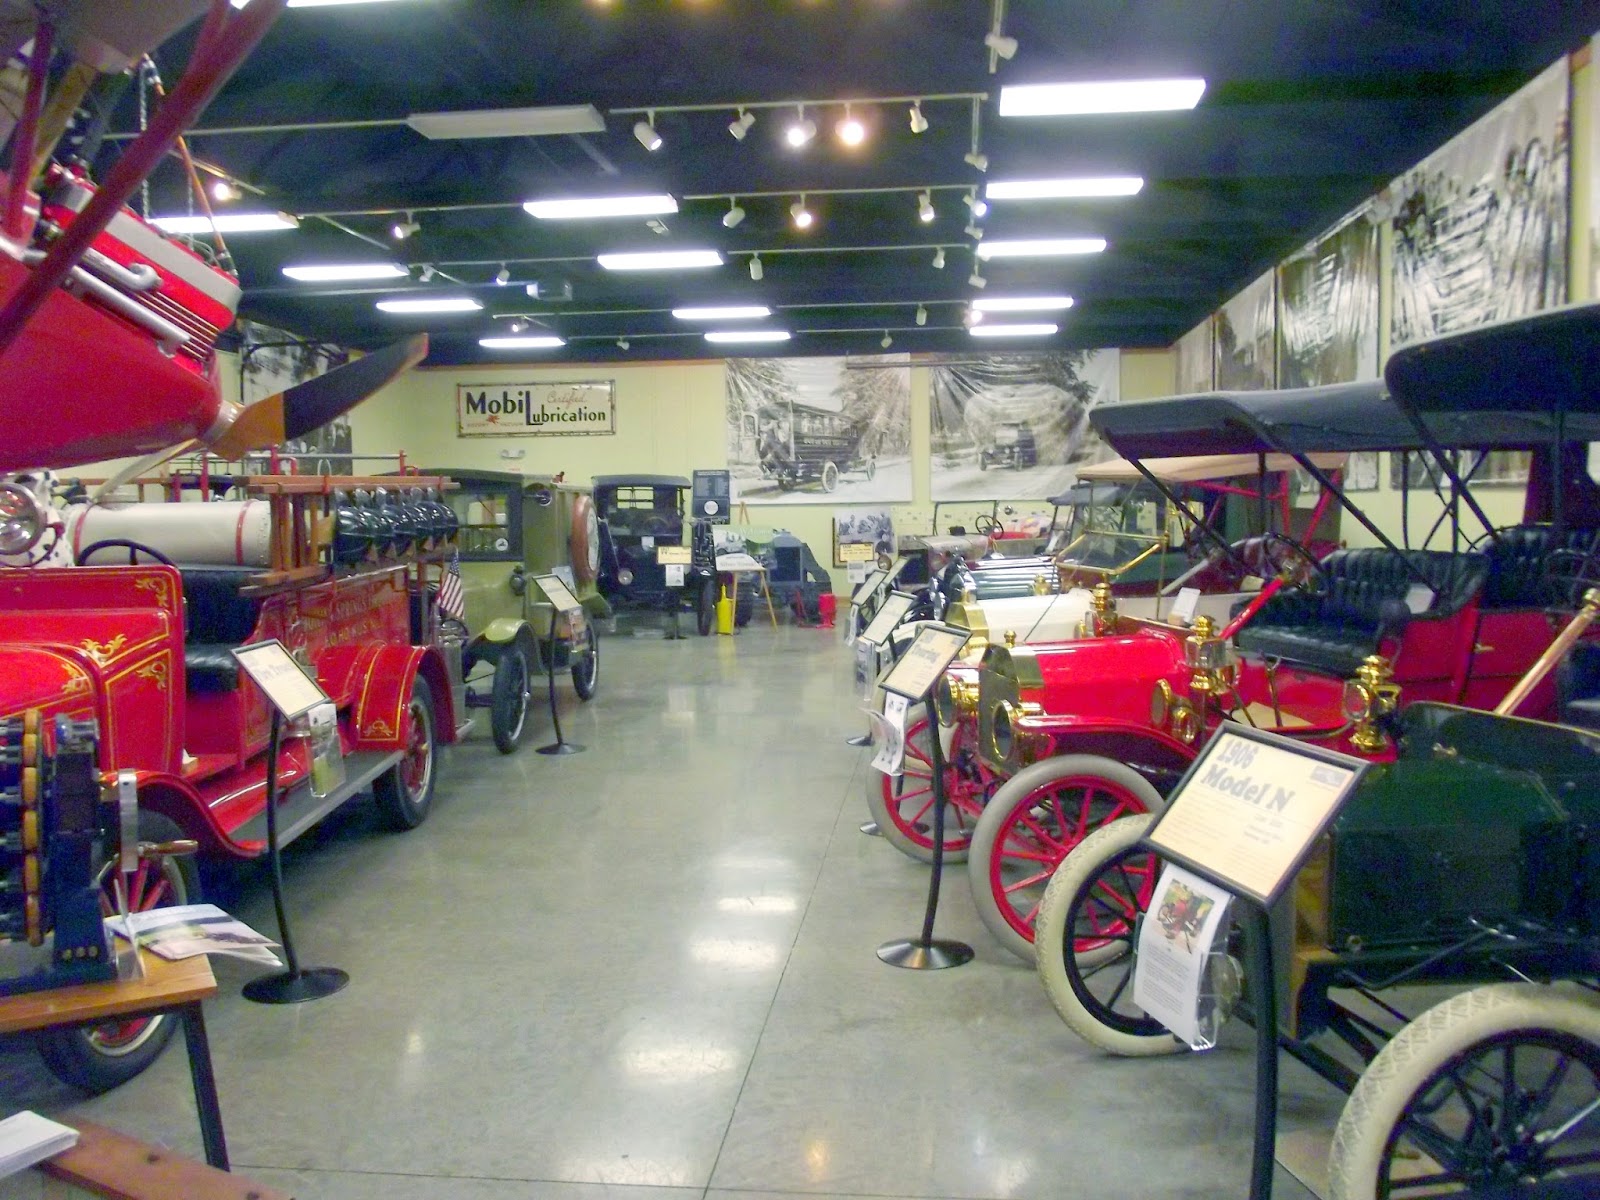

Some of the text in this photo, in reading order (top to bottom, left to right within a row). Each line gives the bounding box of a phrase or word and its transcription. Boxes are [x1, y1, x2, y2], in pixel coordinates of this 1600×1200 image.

[1217, 738, 1260, 769] 1906
[1200, 763, 1296, 812] Model N
